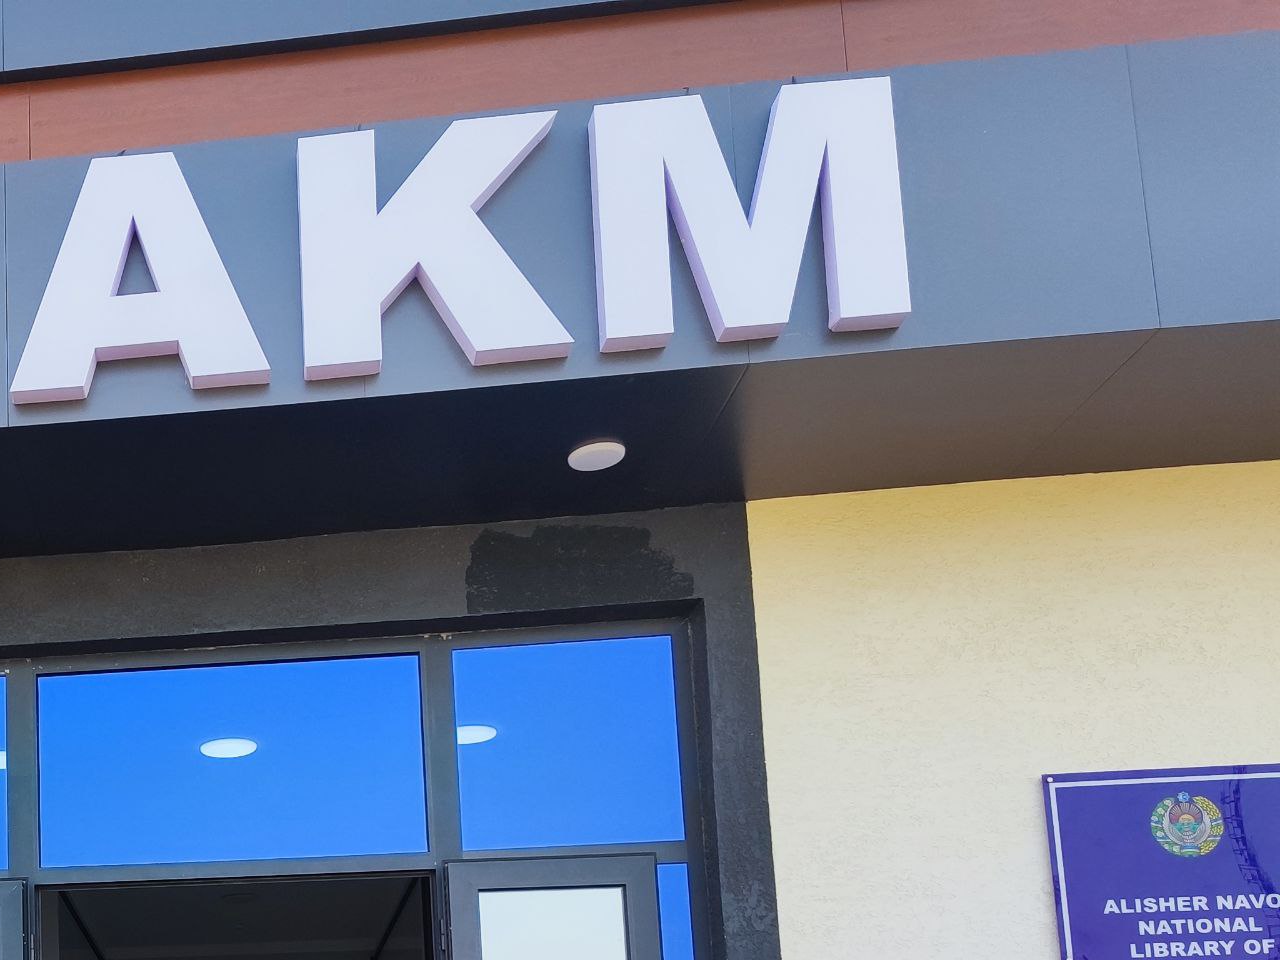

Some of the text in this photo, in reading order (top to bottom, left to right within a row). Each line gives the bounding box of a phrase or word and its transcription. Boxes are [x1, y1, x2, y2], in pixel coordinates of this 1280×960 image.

[10, 76, 912, 404] AKM
[1103, 895, 1210, 915] ALISHER
[1138, 916, 1264, 936] NATIONAL
[1129, 938, 1275, 959] LIBRARY OF
